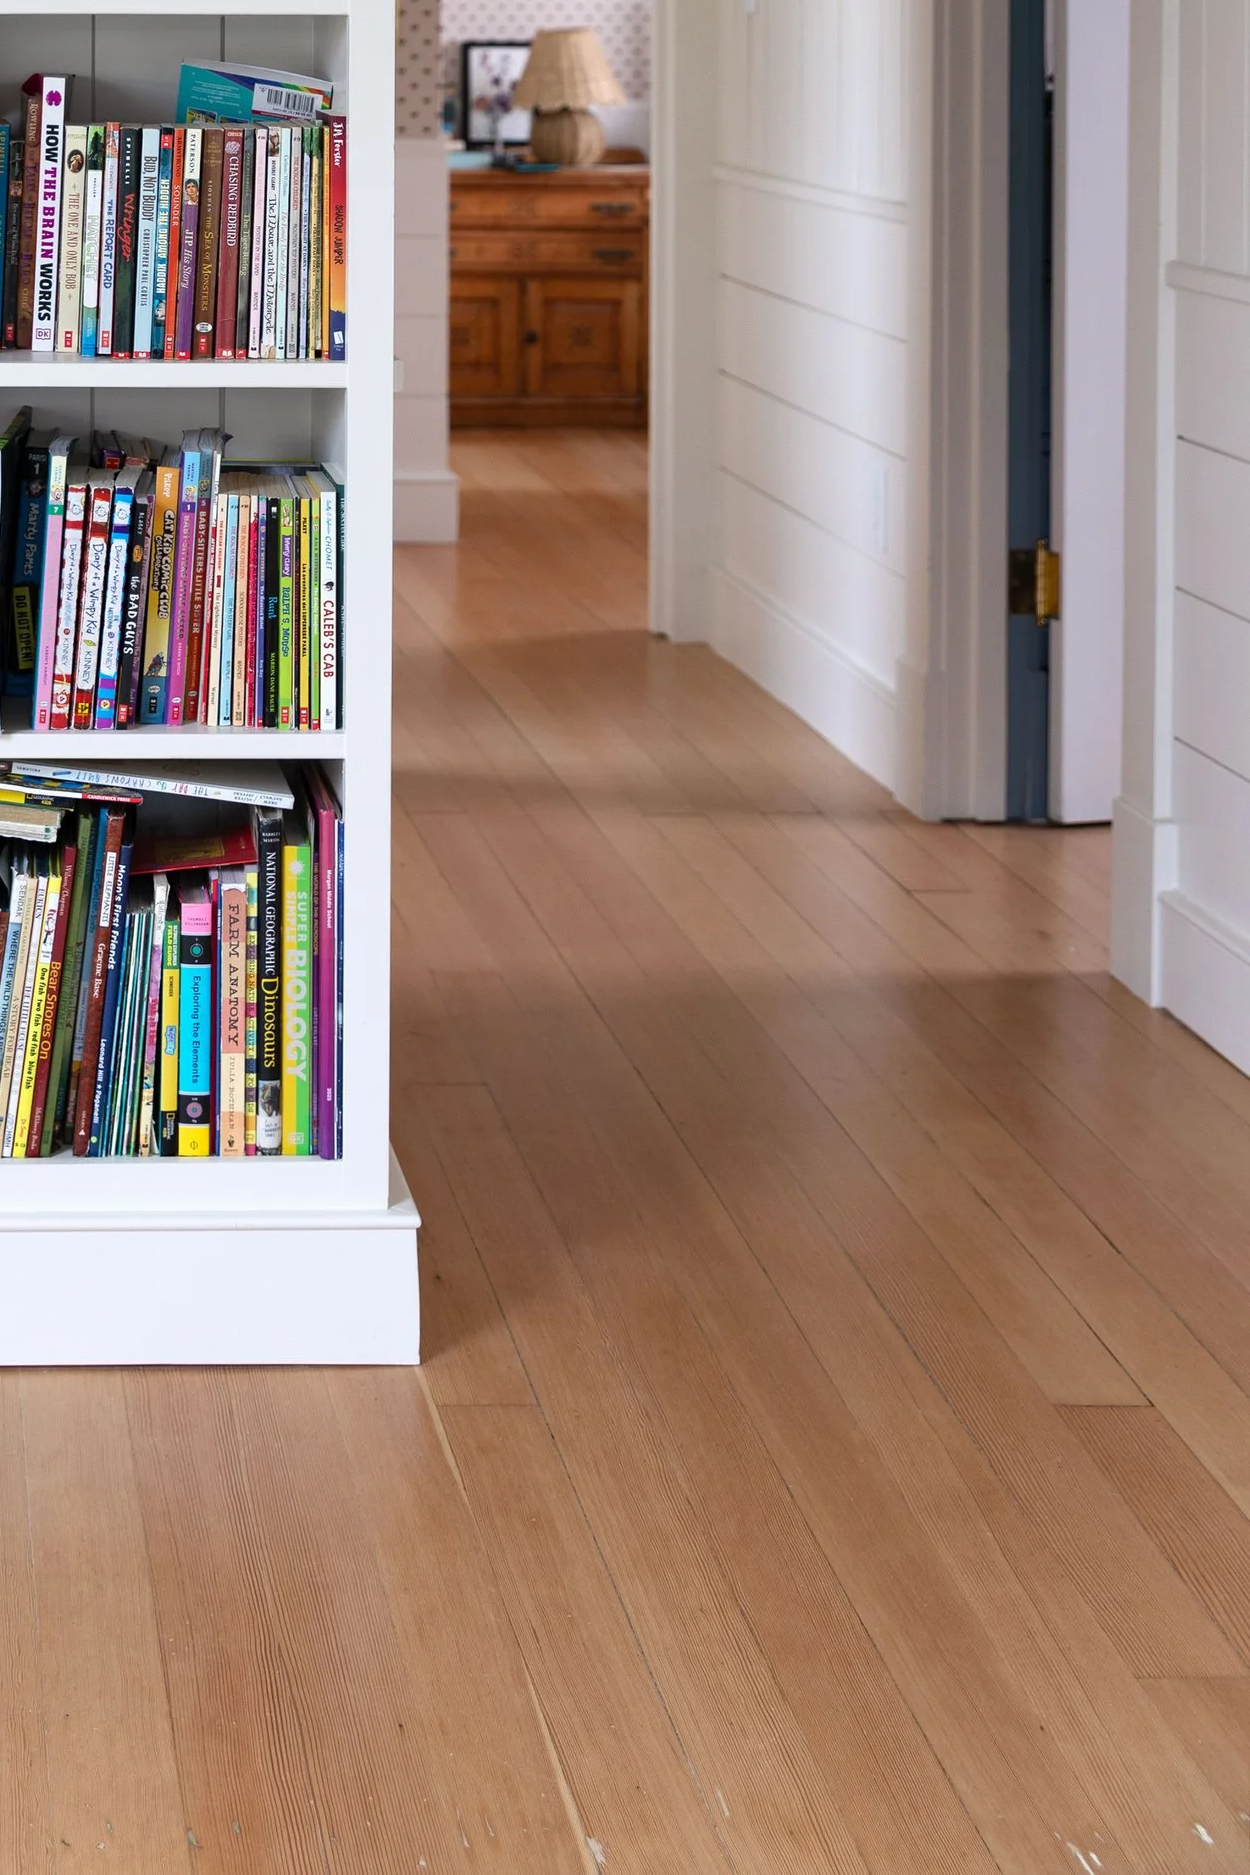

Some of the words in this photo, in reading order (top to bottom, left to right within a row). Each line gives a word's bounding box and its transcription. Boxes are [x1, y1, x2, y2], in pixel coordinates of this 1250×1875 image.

[45, 124, 59, 163] HOW
[143, 156, 157, 175] BUD,
[228, 156, 240, 200] CHASING
[43, 167, 57, 201] THE
[143, 176, 157, 193] NOT
[141, 195, 156, 222] BUDDY
[226, 203, 239, 246] REDBIRD
[334, 204, 343, 234] SHADOW
[40, 206, 56, 259] BRAIN
[103, 219, 114, 260] REPORT
[334, 236, 343, 264] JUMPER
[103, 261, 113, 288] CARD
[37, 263, 53, 321] WORKS
[130, 576, 140, 591] the
[14, 595, 26, 609] DO
[126, 593, 139, 619] BAD
[268, 596, 278, 619] Runt
[16, 611, 29, 631] NOT
[85, 619, 97, 634] Kid
[123, 621, 136, 655] GUYS
[323, 600, 334, 648] CALEB'S
[18, 633, 32, 662] OPEN!
[82, 650, 92, 684] KINNEY
[323, 654, 334, 677] CAB
[114, 864, 126, 902] Moon's
[264, 852, 278, 904] NATIONAL
[111, 904, 123, 927] First
[228, 904, 239, 957] FARM
[286, 891, 297, 942] SIMPLE
[297, 891, 308, 942] SUPER
[8, 929, 20, 954] WHERE
[107, 929, 121, 970] Friends
[264, 906, 277, 975] GEOGRAPHIC
[5, 956, 17, 977] THE
[46, 961, 62, 993] Bear
[3, 979, 14, 1001] WILD
[190, 975, 201, 1017] Exploring
[227, 964, 239, 1046] ANATOMY
[41, 994, 58, 1037] Snores
[191, 1022, 201, 1037] the
[260, 976, 280, 1067] Dinosaurs
[285, 948, 307, 1081] BIOLOGY
[39, 1039, 53, 1059] On
[191, 1040, 201, 1084] Elements
